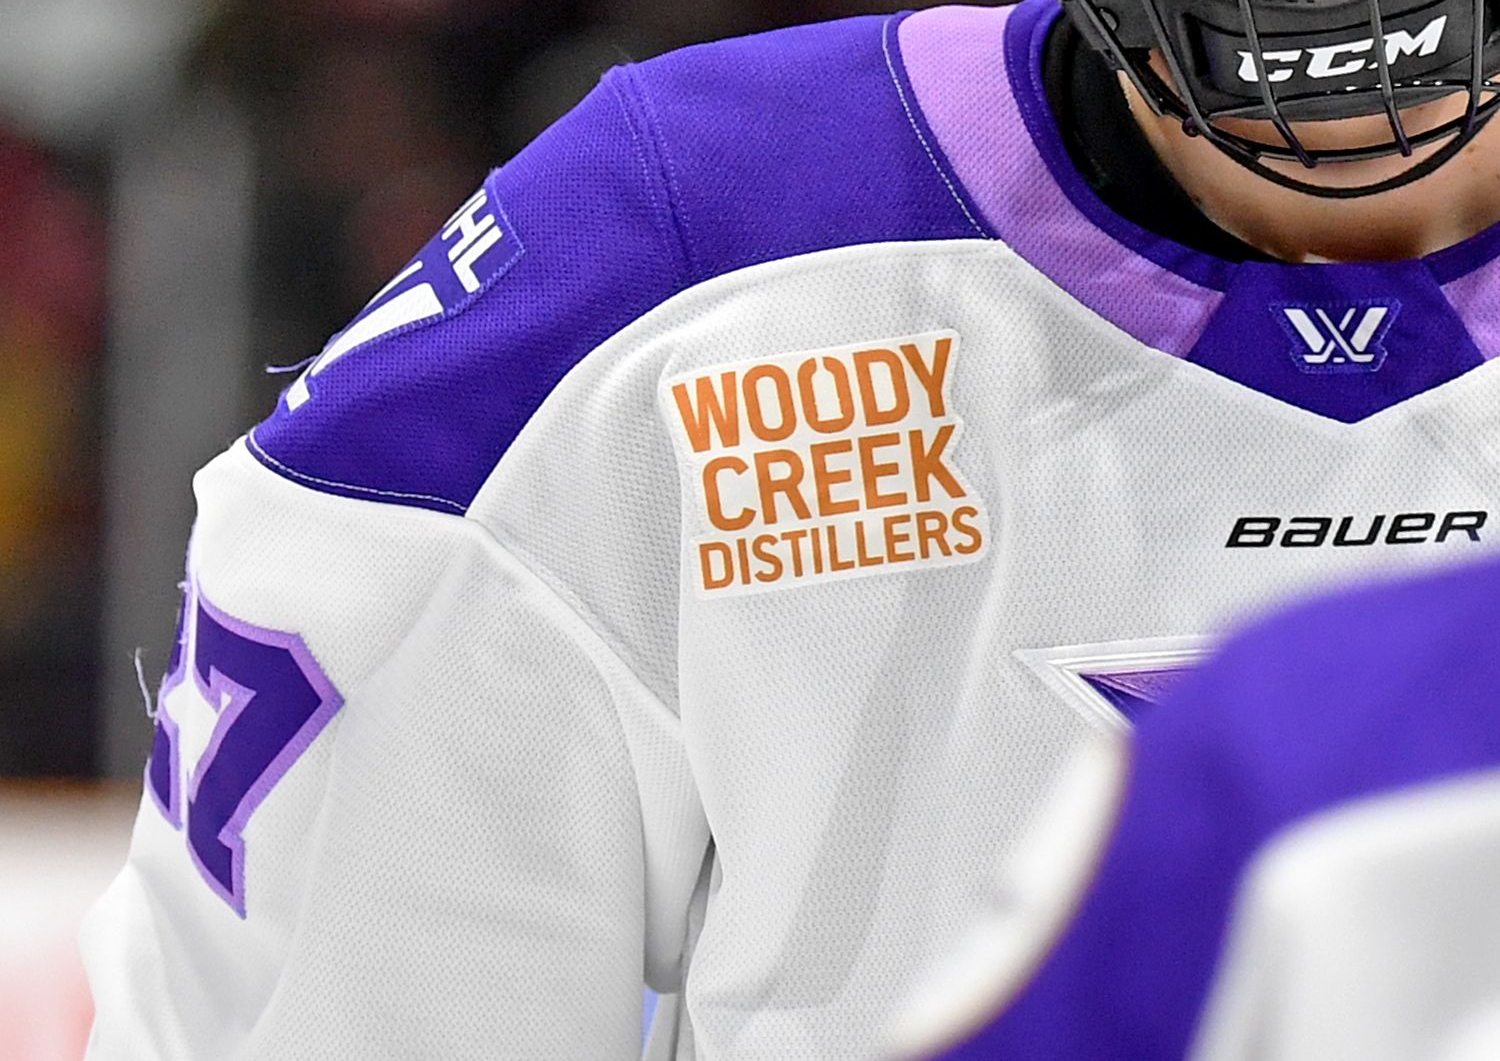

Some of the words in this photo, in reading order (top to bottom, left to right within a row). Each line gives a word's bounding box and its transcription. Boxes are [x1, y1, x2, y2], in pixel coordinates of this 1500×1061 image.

[1236, 14, 1449, 84] CCM
[438, 187, 504, 294] HL
[671, 337, 953, 454] WOODY
[702, 424, 967, 532] CREEK
[698, 505, 983, 591] DISTILLERS
[147, 538, 346, 921] 7
